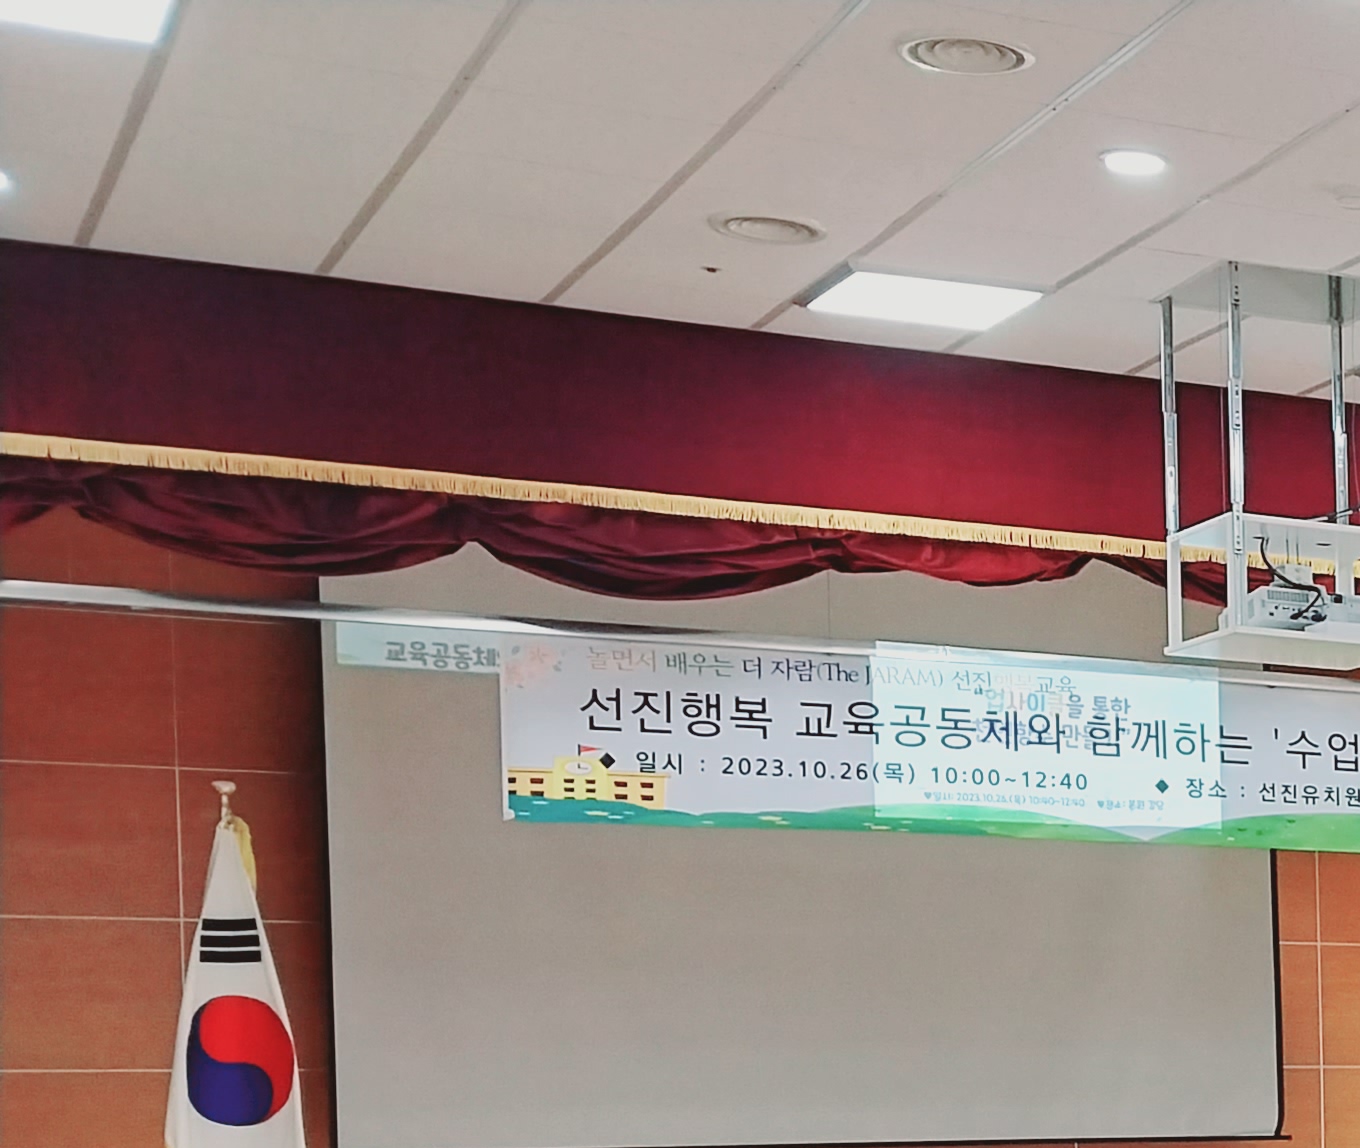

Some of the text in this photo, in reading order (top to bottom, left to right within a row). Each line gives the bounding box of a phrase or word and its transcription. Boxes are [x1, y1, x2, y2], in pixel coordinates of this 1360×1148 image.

[385, 640, 500, 670] 교육공동체
[587, 646, 656, 673] 놀면서
[664, 652, 734, 678] 배우는
[742, 656, 762, 680] 더
[865, 664, 944, 688] JARAM)
[579, 687, 773, 740] 선진행복
[795, 701, 1067, 754] 교육공동체와
[1086, 714, 1253, 765] 함께하는
[1273, 727, 1360, 772] '수업
[636, 751, 683, 775] 일시
[721, 756, 916, 785] 2023.10.26(목)
[930, 766, 1089, 791] 10:00~12:40
[1185, 777, 1228, 799] 장소
